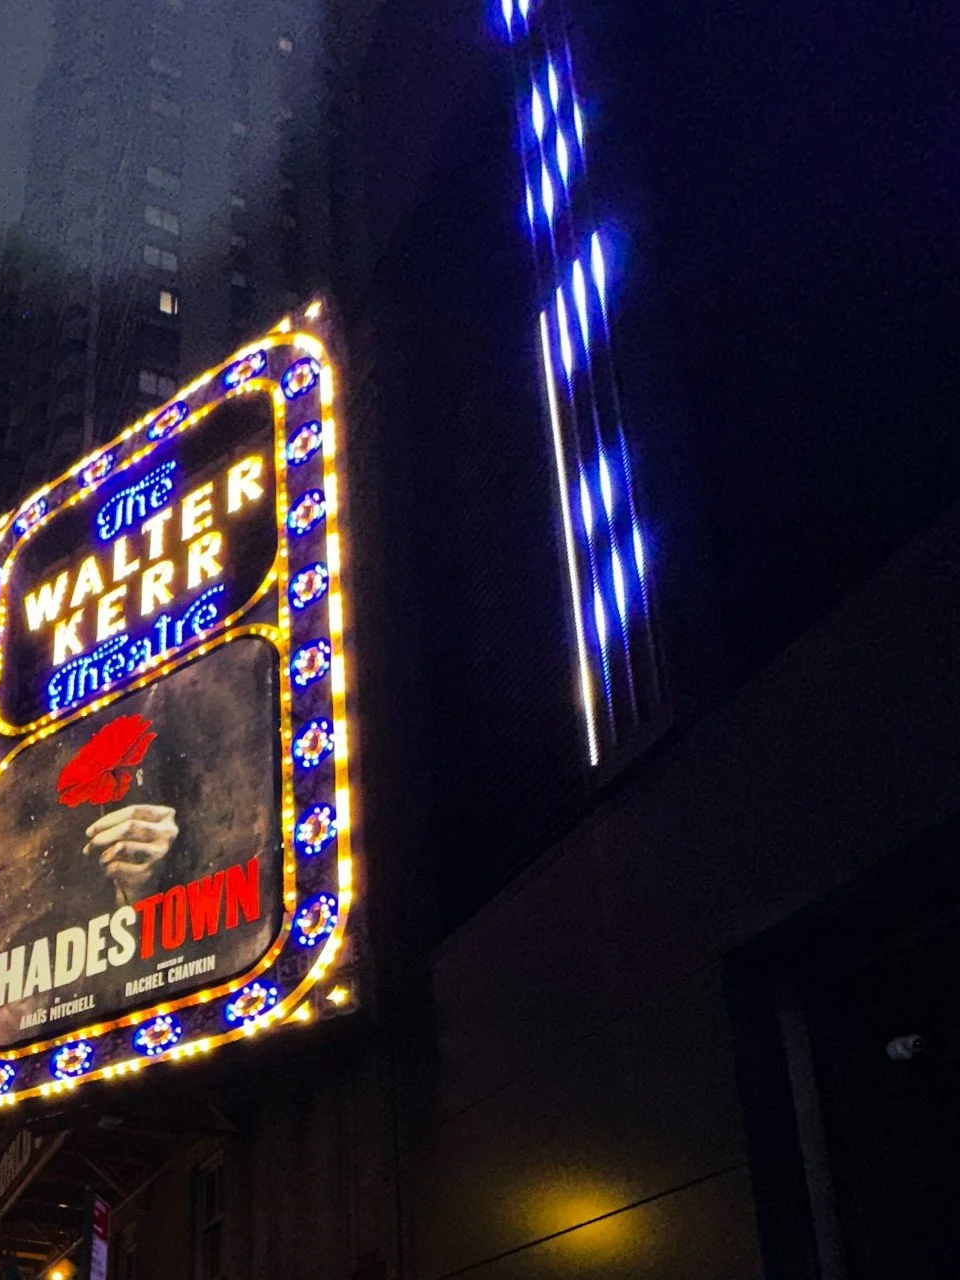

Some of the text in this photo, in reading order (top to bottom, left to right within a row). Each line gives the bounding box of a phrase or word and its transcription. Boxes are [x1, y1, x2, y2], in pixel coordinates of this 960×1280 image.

[24, 455, 264, 632] WALTER
[96, 459, 177, 541] The
[46, 584, 226, 714] Theatre
[53, 531, 223, 667] KERR
[49, 994, 96, 1021] MITCHELL
[125, 954, 216, 997] RACHEL CHAVKIN
